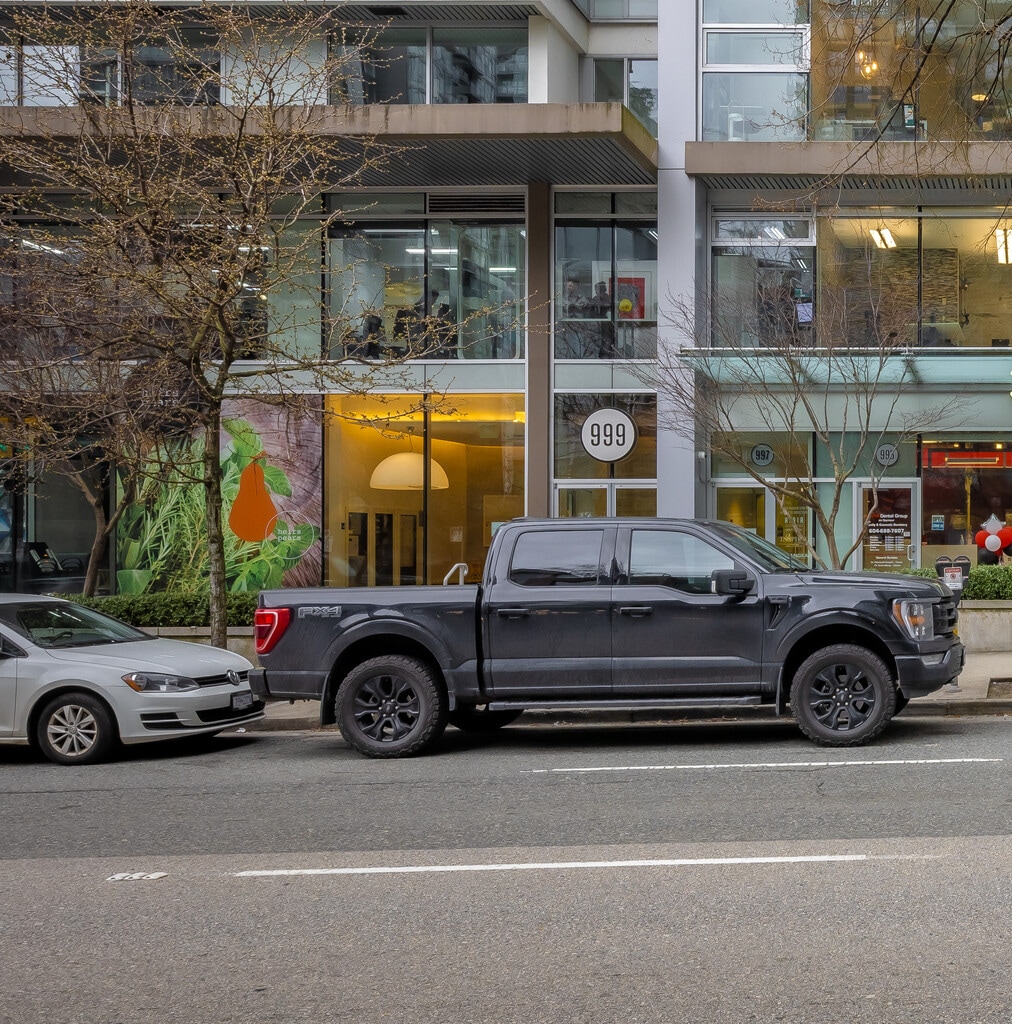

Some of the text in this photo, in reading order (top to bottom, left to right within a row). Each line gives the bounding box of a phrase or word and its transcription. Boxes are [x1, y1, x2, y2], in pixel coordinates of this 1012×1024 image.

[590, 423, 626, 446] 999
[755, 450, 770, 460] 997
[298, 606, 342, 618] FX4
